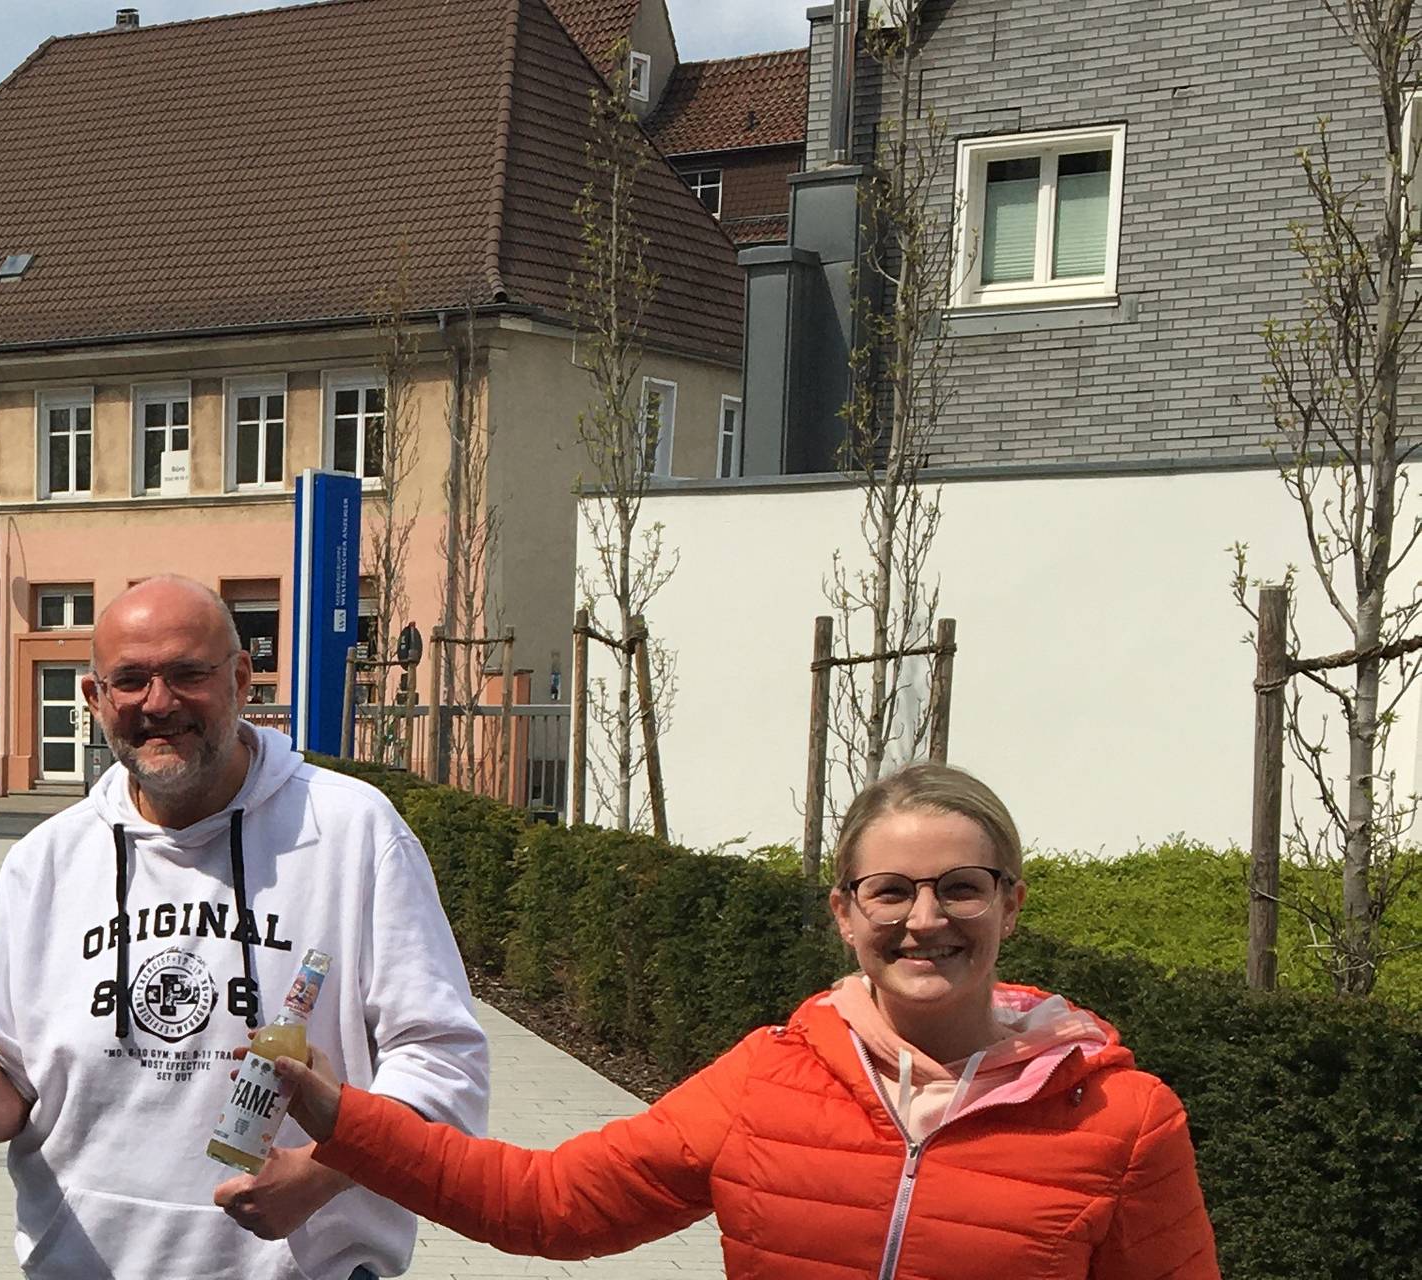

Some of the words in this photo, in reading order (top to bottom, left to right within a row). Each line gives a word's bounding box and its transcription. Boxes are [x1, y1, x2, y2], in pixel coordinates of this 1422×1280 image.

[83, 901, 293, 960] ORIGINAL
[215, 1051, 233, 1060] TRA
[140, 1060, 163, 1069] MOST
[166, 1061, 211, 1071] EFFECTIVE
[156, 1071, 172, 1081] SET
[175, 1072, 193, 1082] OUT
[230, 1078, 280, 1120] FAME
